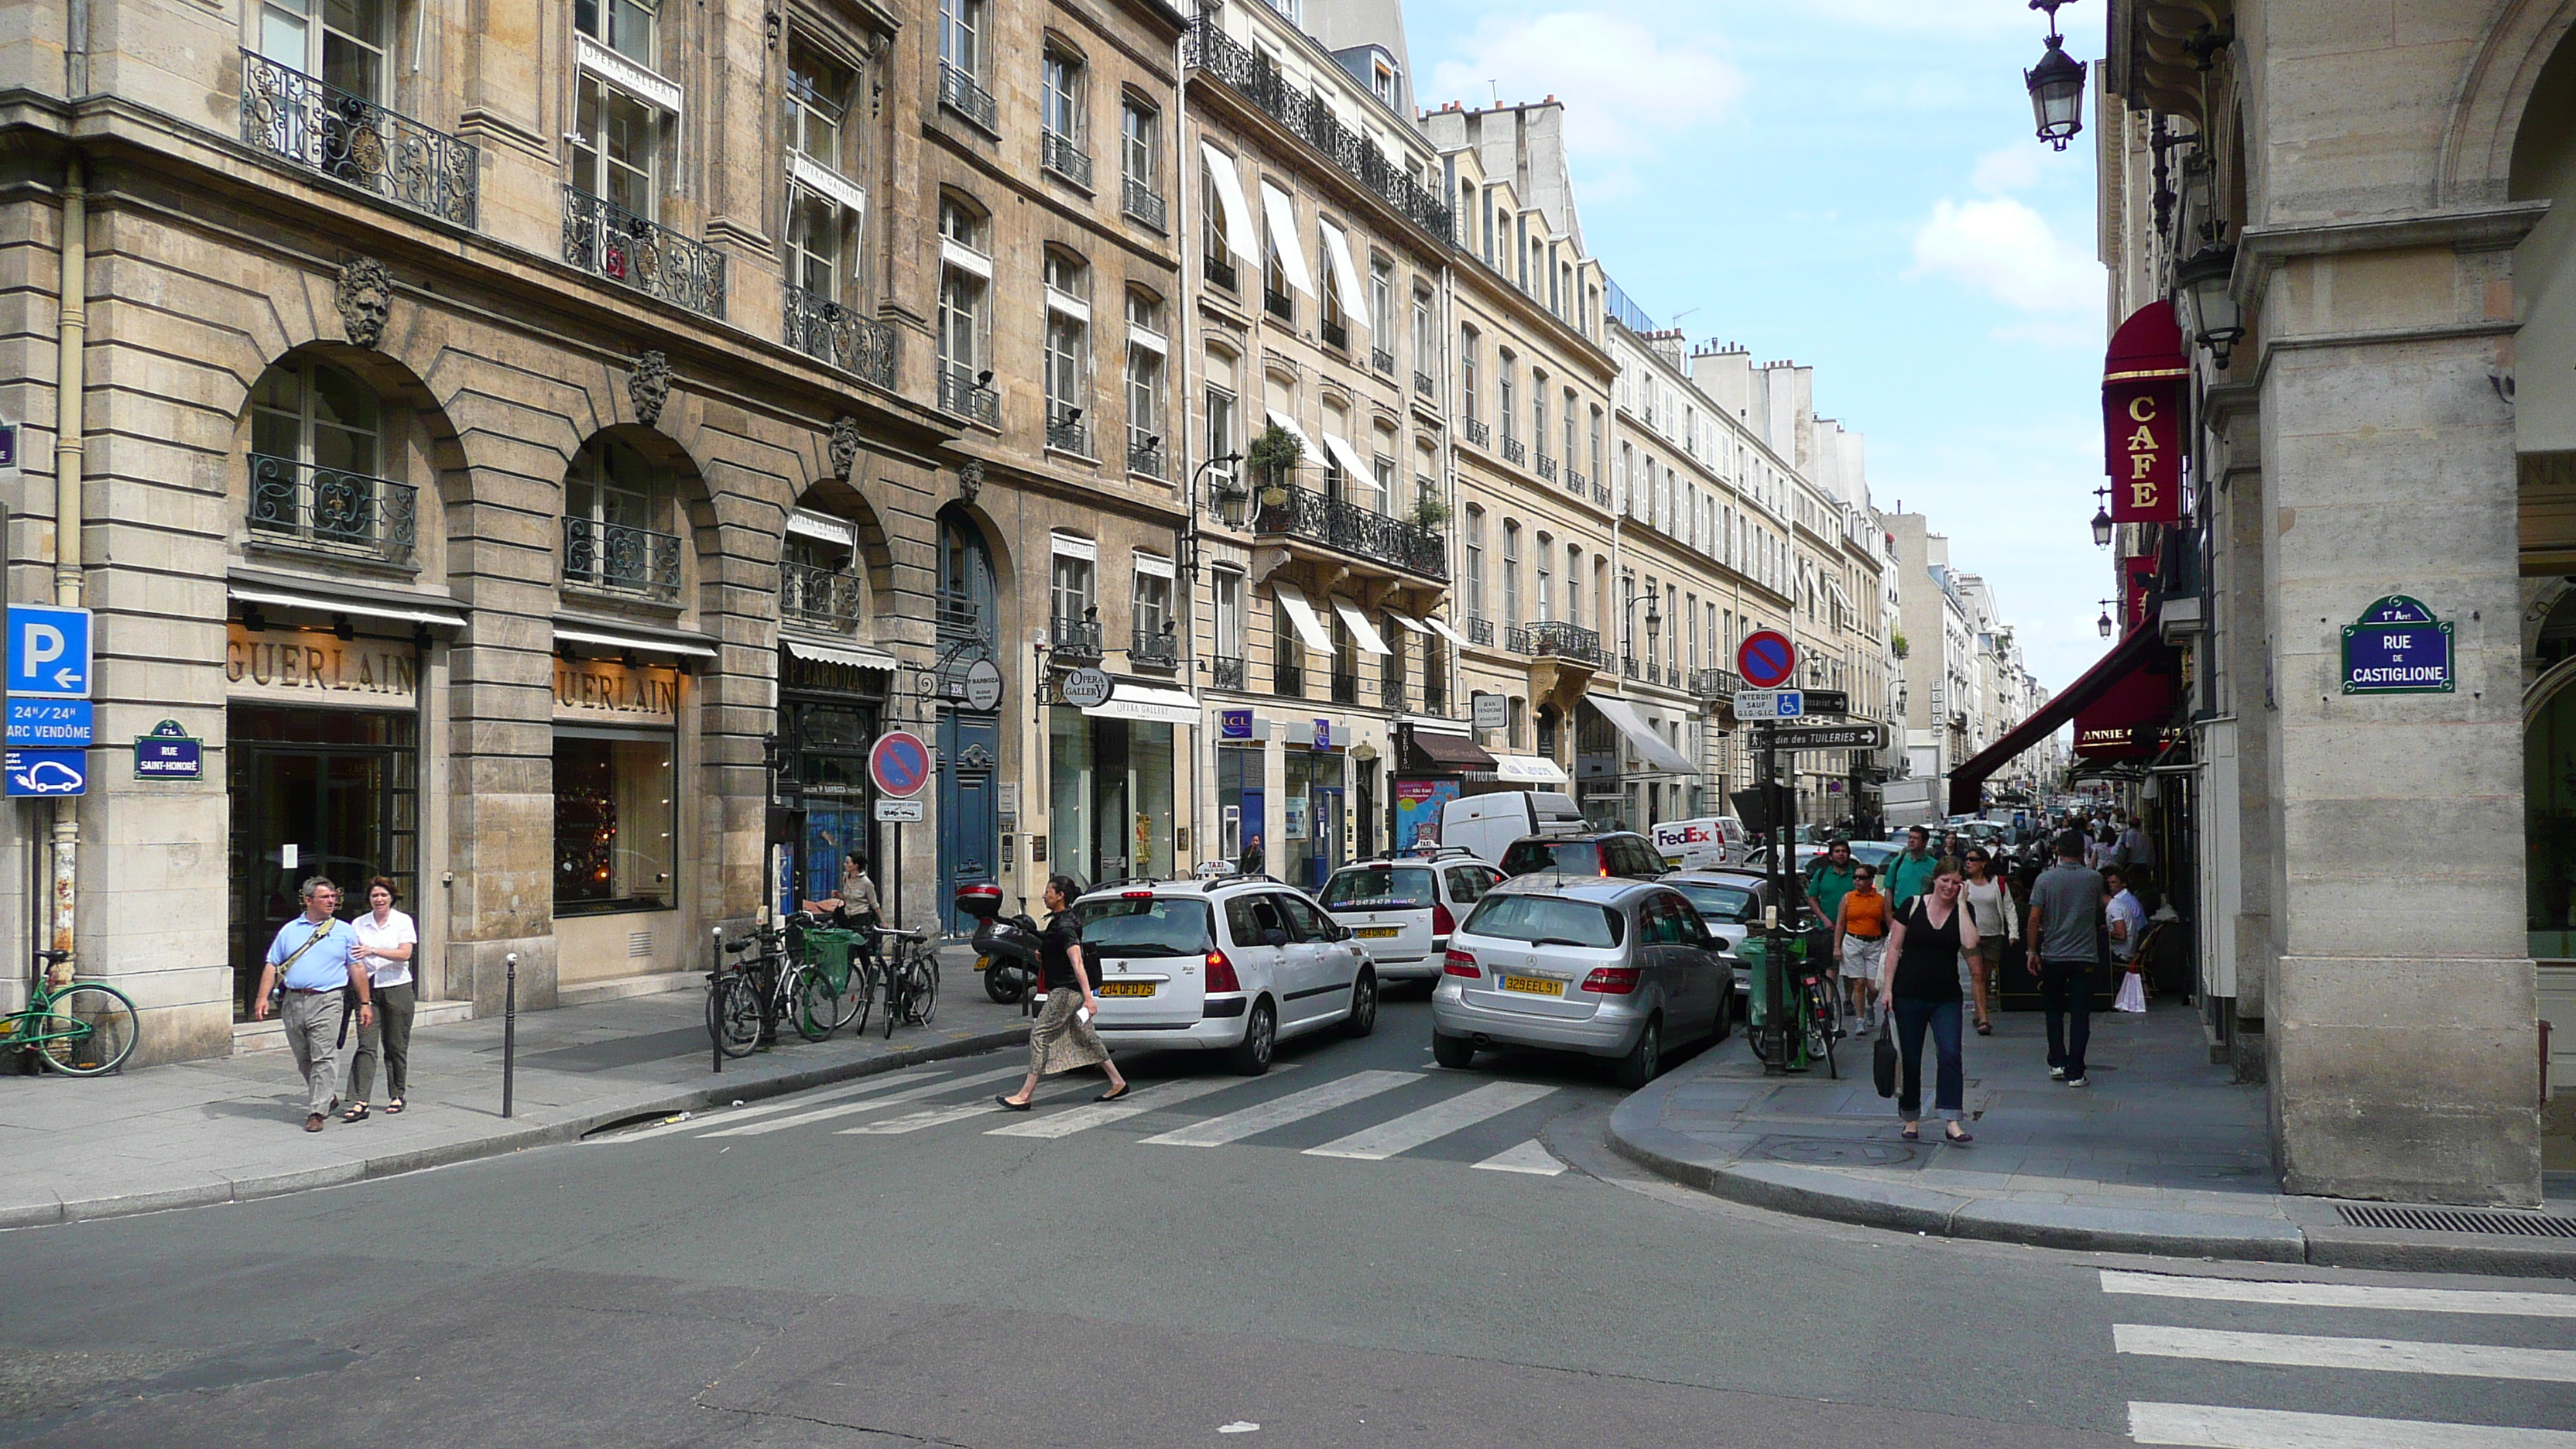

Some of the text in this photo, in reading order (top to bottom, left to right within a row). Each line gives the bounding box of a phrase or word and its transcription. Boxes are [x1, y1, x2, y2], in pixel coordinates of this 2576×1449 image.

[2127, 396, 2159, 508] CAFE
[2383, 635, 2412, 649] RUE
[24, 623, 65, 677] P
[227, 640, 414, 697] GUERLAIN
[2353, 666, 2444, 682] CASTIGLIONE
[1070, 671, 1105, 685] OPERA
[553, 670, 675, 715] UERLAIN
[1065, 684, 1105, 699] GALLERY
[1117, 703, 1170, 716] OPERA GALLERY
[1804, 698, 1831, 707] issariat
[1223, 716, 1249, 726] LCL
[7, 724, 91, 738] ARC VENDÔME
[1791, 735, 1806, 744] des
[1810, 732, 1855, 743] TUILERIES
[2083, 730, 2123, 740] ANNIE
[161, 746, 178, 755] RUE
[141, 759, 197, 771] SAINT-HONORÉ
[1657, 826, 1711, 846] FedEx
[1100, 984, 1118, 995] 234
[1141, 983, 1153, 994] 75
[1506, 978, 1558, 994] 329 EEL 91
